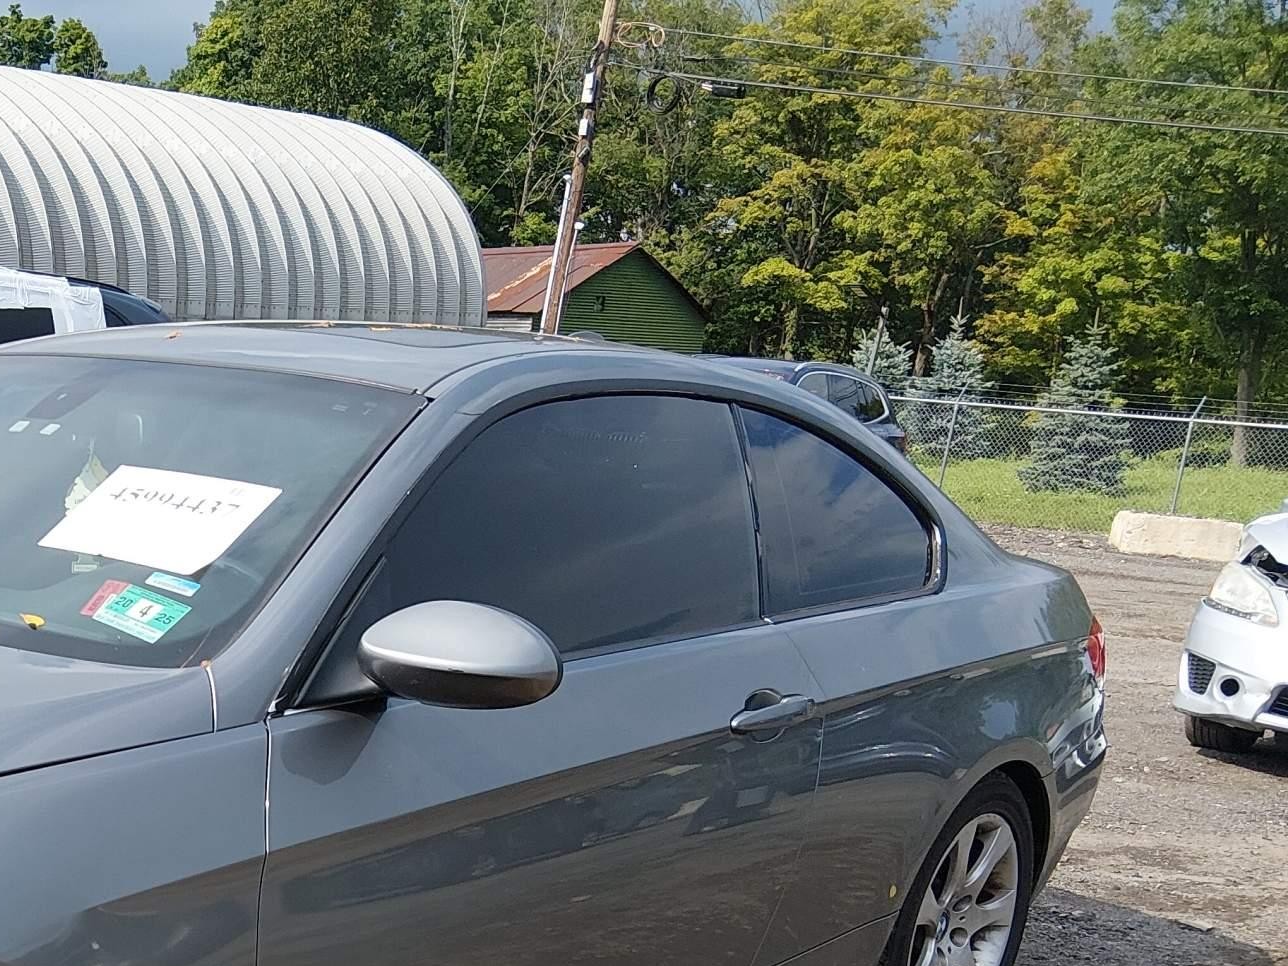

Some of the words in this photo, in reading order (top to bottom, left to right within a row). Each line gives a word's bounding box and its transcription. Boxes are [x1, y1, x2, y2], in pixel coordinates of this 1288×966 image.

[115, 596, 133, 608] 20
[139, 604, 154, 618] 4
[155, 612, 175, 625] 25
